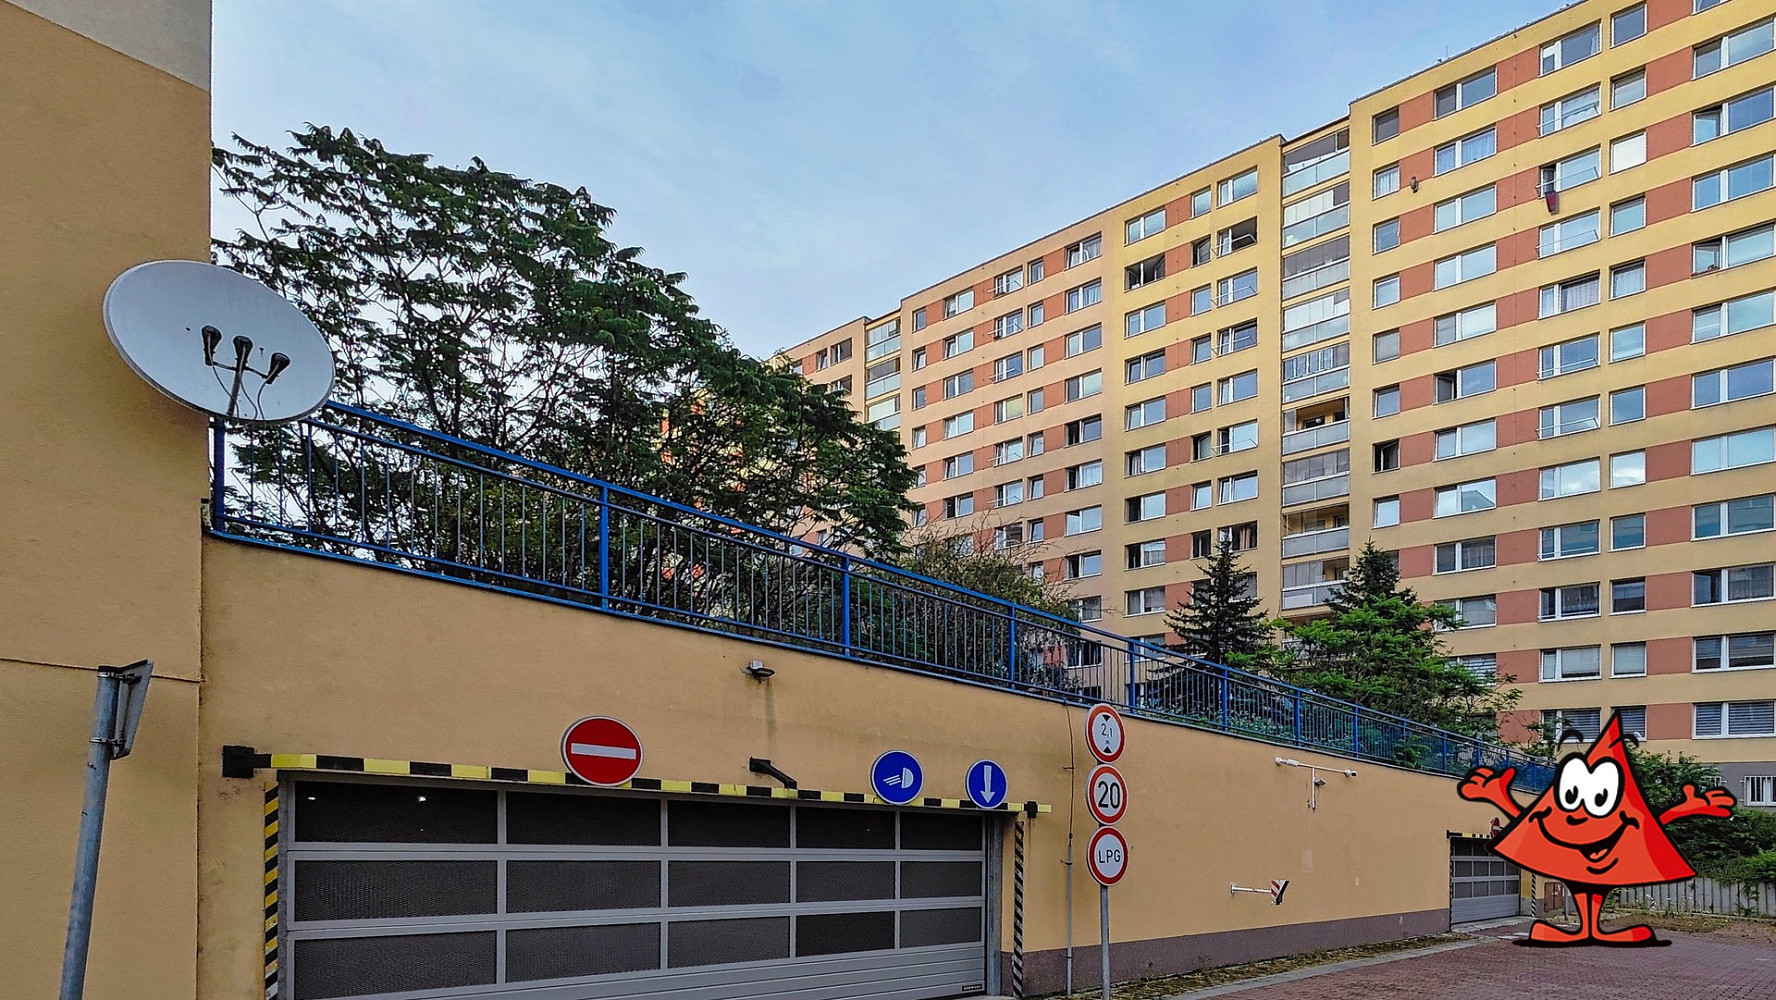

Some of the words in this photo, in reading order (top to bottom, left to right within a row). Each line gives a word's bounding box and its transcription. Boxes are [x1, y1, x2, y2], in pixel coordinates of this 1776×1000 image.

[1101, 723, 1113, 737] 2,1
[1098, 780, 1120, 809] 20
[1098, 849, 1120, 863] LPG
